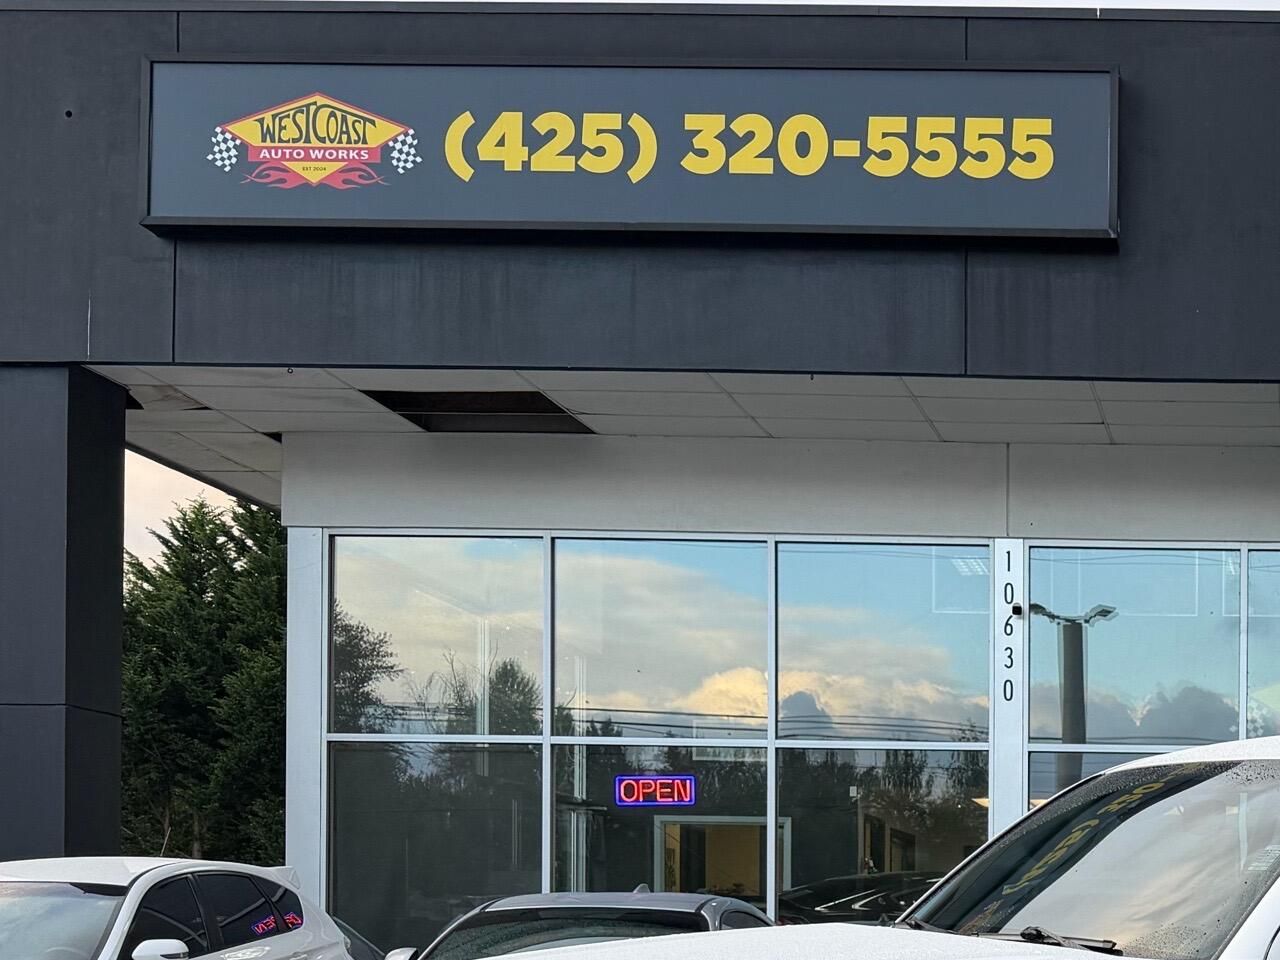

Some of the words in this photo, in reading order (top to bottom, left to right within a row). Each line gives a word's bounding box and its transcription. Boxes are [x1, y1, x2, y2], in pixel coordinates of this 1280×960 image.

[259, 149, 305, 160] AUTO
[309, 149, 369, 160] WORKS
[444, 110, 658, 184] (425)
[679, 112, 1055, 181] 320-5555
[1003, 550, 1015, 702] 10630
[620, 779, 691, 802] OPEN
